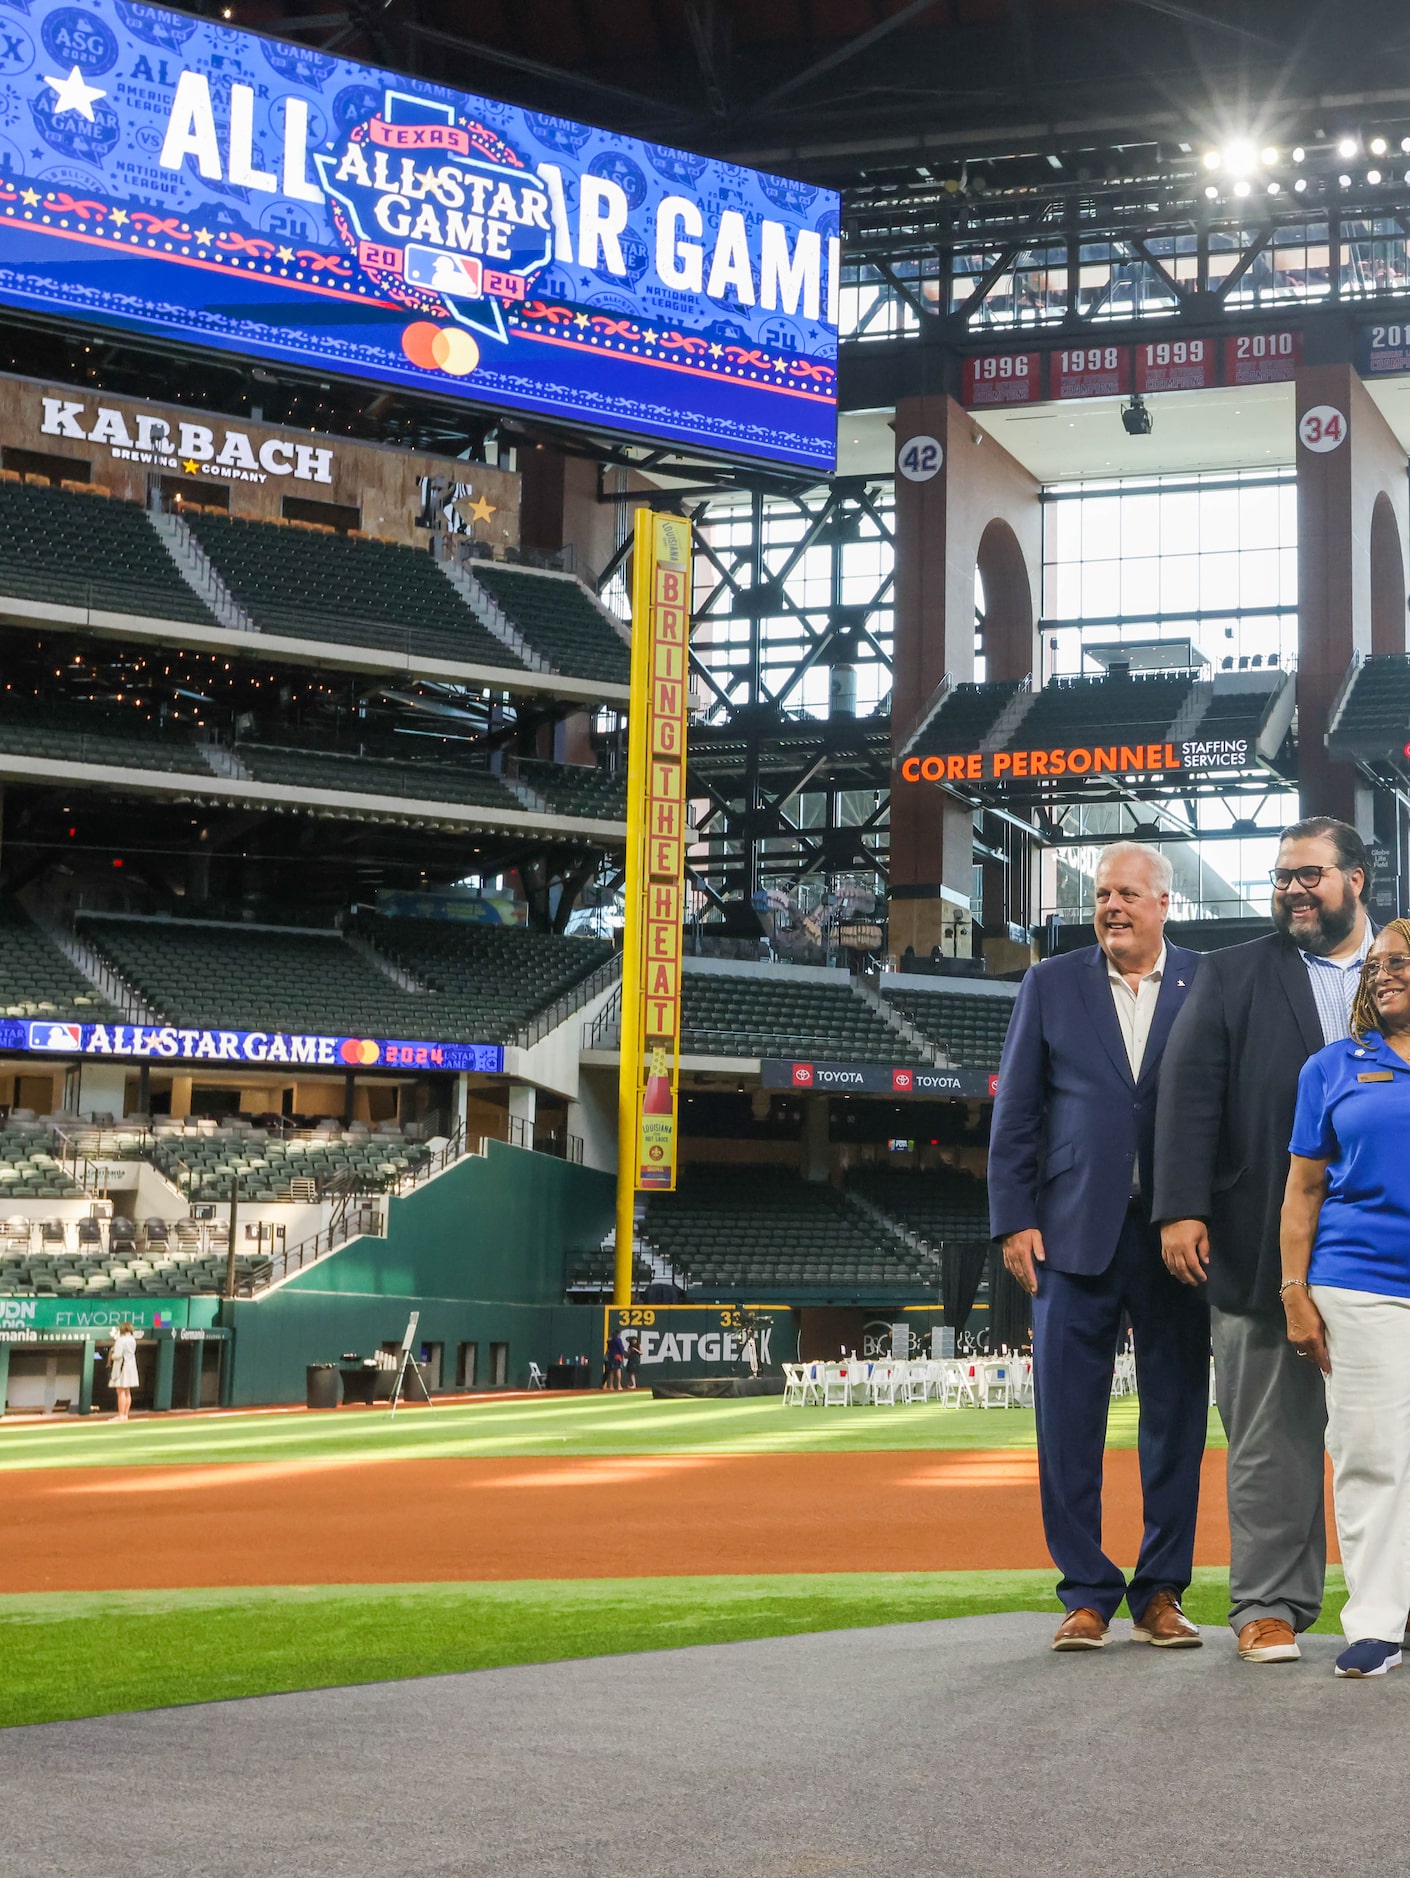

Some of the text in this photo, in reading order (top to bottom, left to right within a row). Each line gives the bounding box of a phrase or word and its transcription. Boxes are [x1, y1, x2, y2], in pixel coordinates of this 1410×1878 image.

[56, 28, 104, 55] ASG
[117, 83, 176, 105] AMERIC
[127, 98, 172, 116] LEAGU
[51, 115, 103, 139] GAME
[161, 70, 326, 204] ALL
[381, 126, 460, 147] TEXAS
[116, 160, 187, 186] NATIONAL
[124, 173, 178, 195] LEAGUE
[373, 193, 512, 261] GAME
[366, 246, 396, 268] 20
[489, 273, 518, 295] 24
[1145, 340, 1204, 366] 1999
[1236, 333, 1292, 359] 2010
[972, 356, 1029, 380] 1996
[1061, 347, 1118, 373] 1998
[41, 397, 334, 484] KARBACH
[1304, 414, 1343, 444] 34
[111, 447, 268, 484] BREWING COMPANY
[903, 445, 938, 472] 42
[901, 739, 1248, 783] CORE PERSONNEL STAFFING
[1184, 752, 1247, 768] SERVICES
[653, 573, 679, 1033] BRING THE HEAT
[243, 1031, 336, 1065] GAME
[385, 1045, 443, 1065] 2024
[817, 1070, 864, 1084] TOYOTA
[915, 1075, 961, 1089] TOYOTA
[56, 1311, 74, 1326] FT
[77, 1311, 145, 1327] WORTH
[618, 1310, 656, 1327] 329
[720, 1311, 757, 1328] 33
